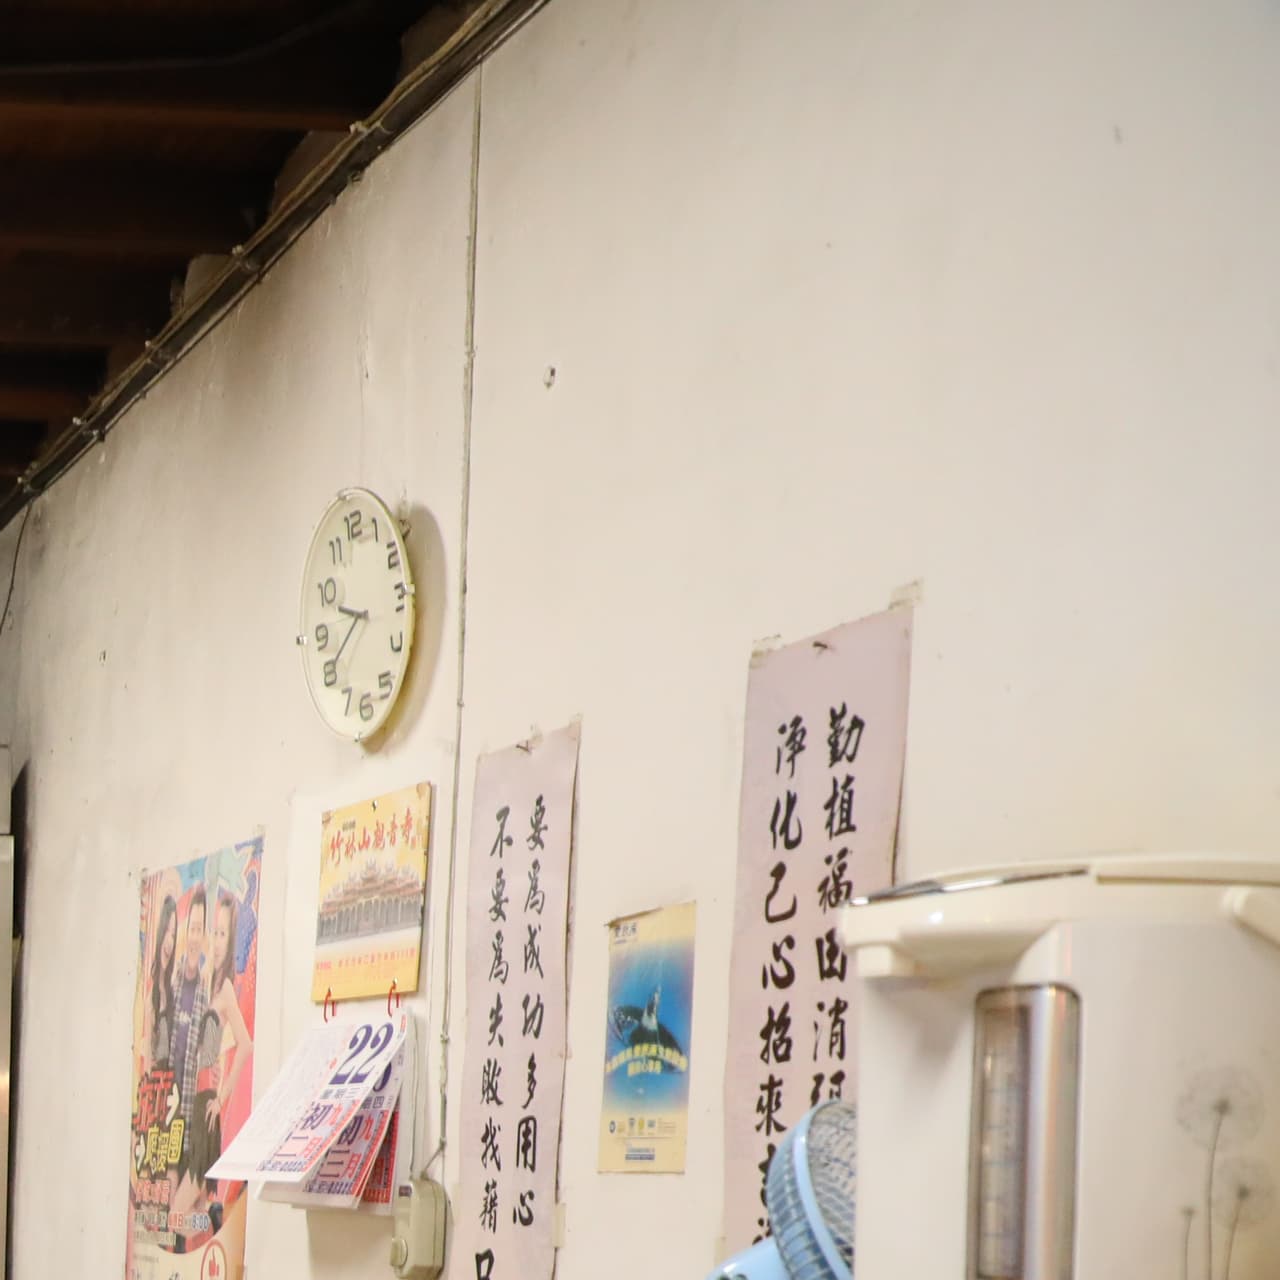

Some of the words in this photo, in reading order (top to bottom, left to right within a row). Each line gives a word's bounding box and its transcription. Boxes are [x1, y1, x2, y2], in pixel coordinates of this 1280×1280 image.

[344, 510, 362, 541] 12
[371, 517, 379, 542] 1
[329, 536, 343, 565] 11
[317, 577, 337, 607] 10
[315, 624, 329, 651] 9
[323, 660, 338, 687] 8
[378, 671, 393, 700] 5
[342, 687, 353, 716] 7
[359, 692, 374, 721] 6
[329, 1022, 395, 1085] 22
